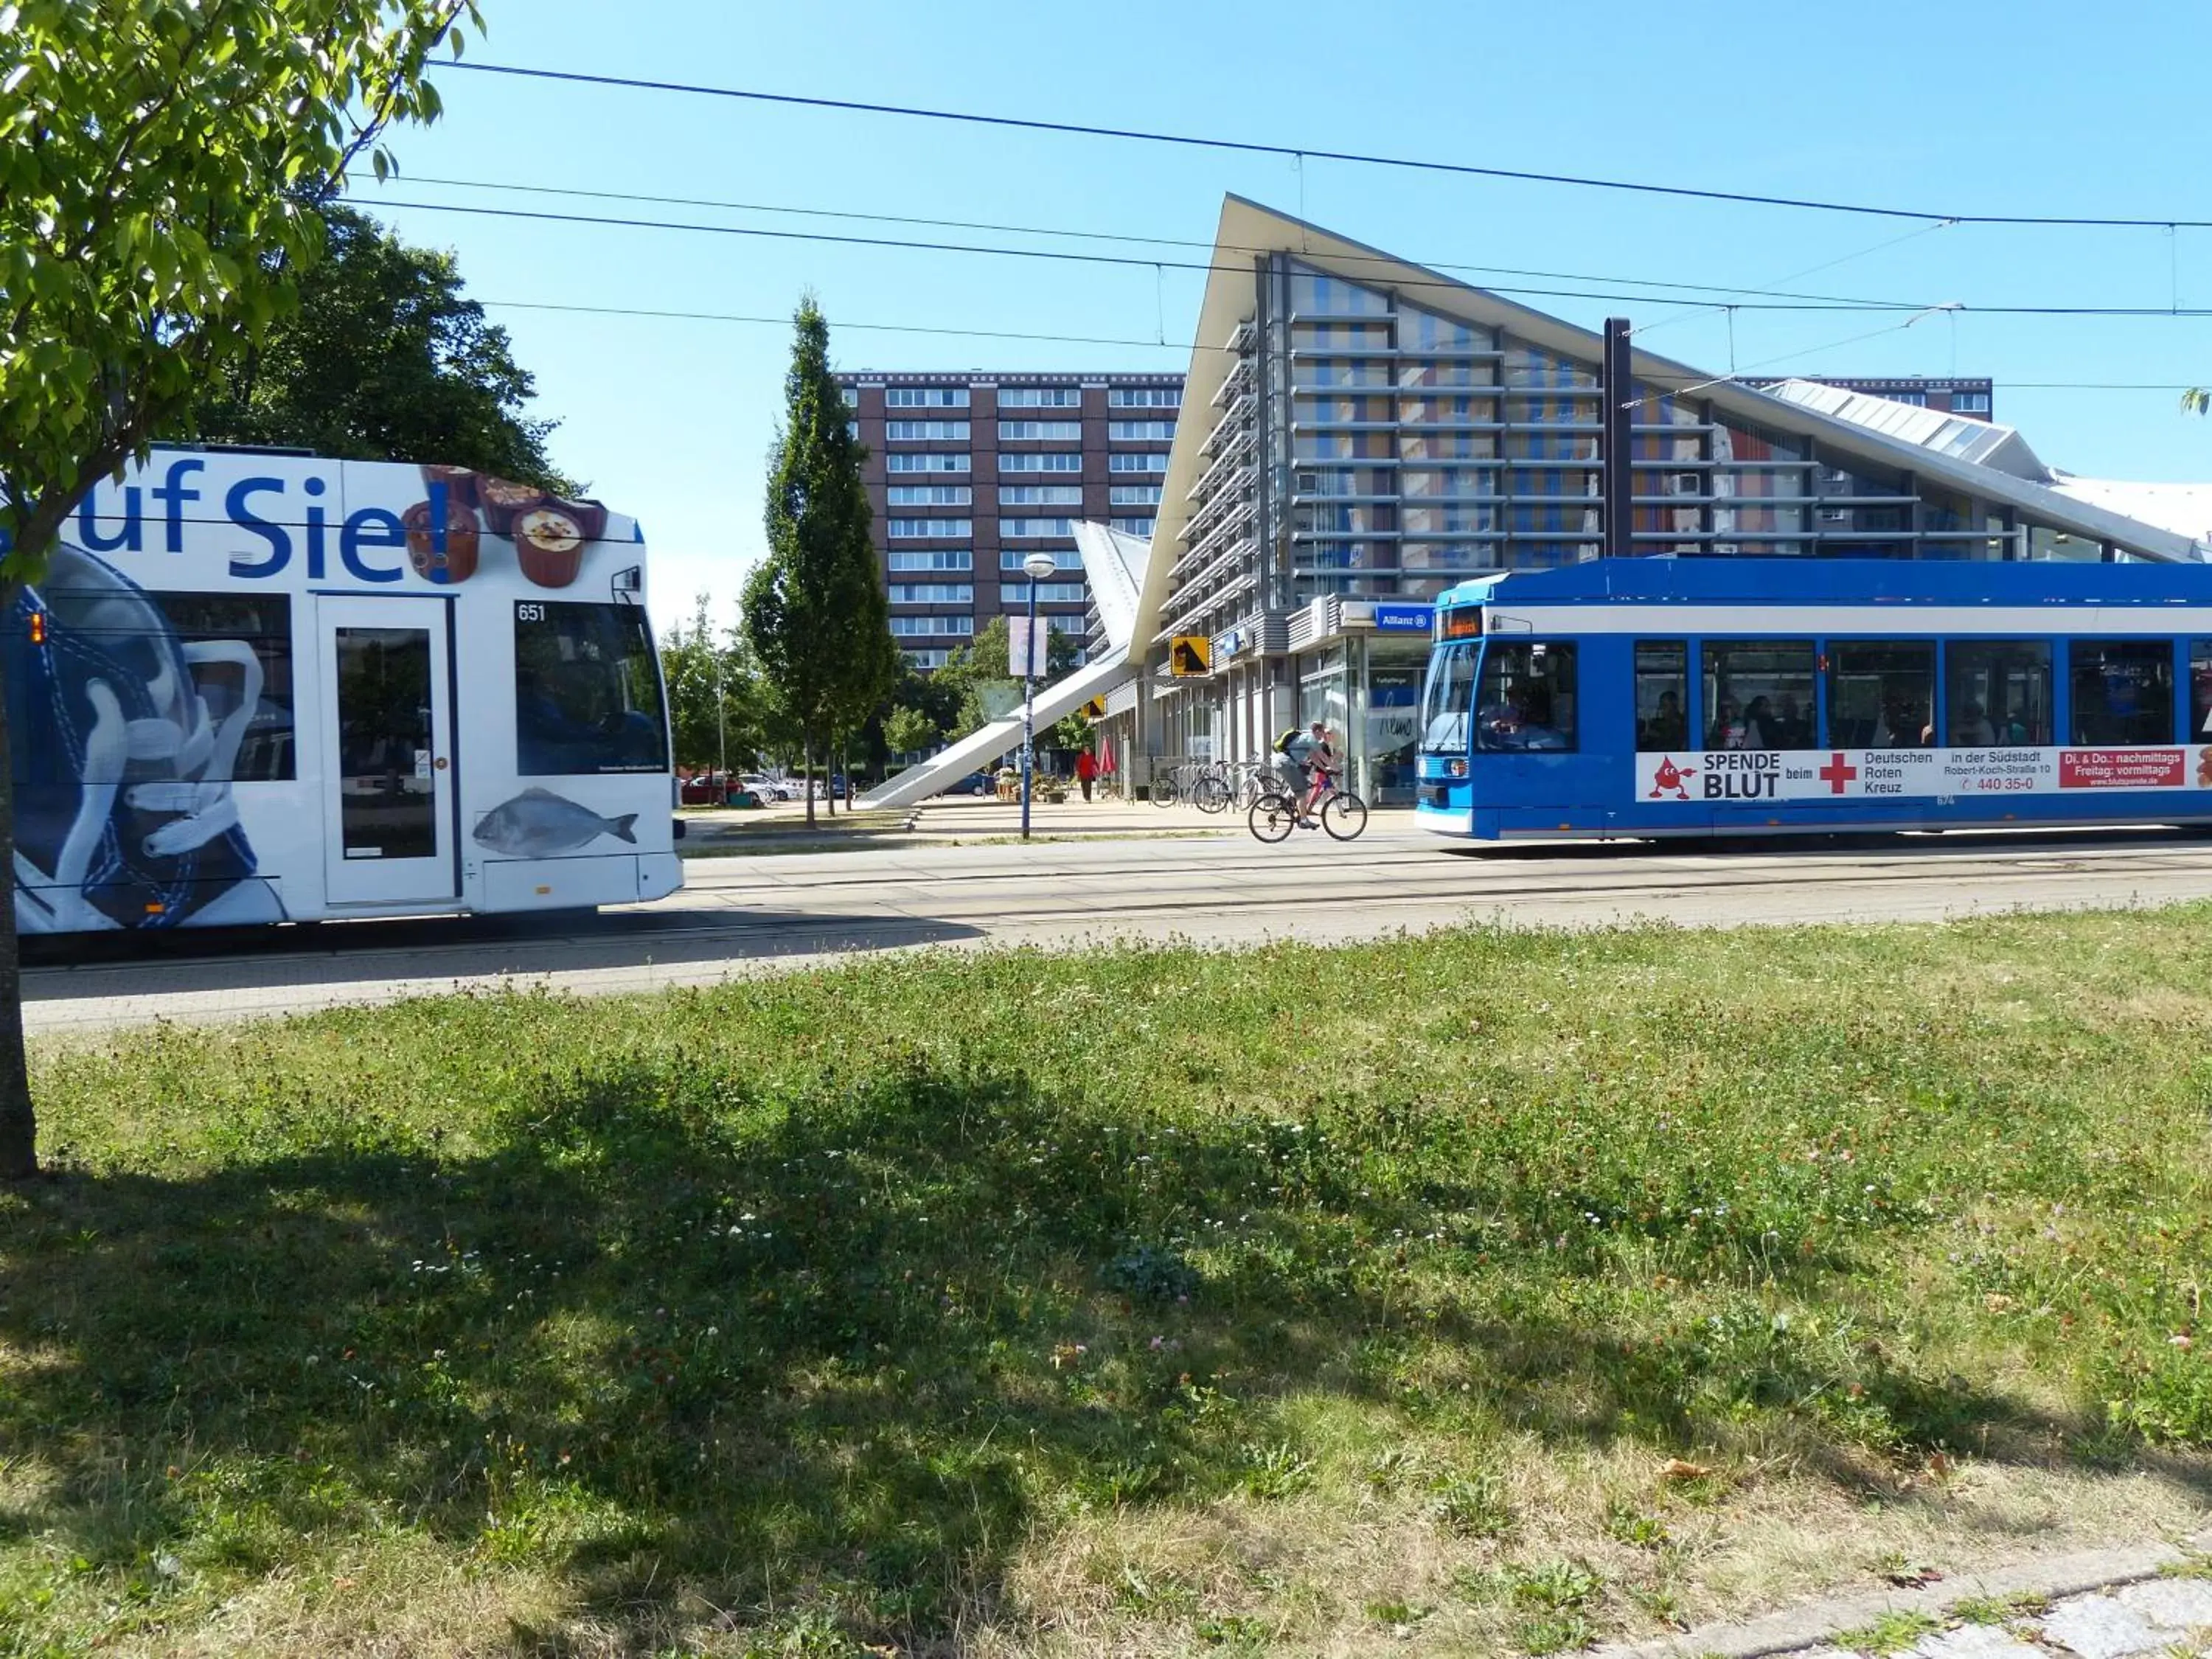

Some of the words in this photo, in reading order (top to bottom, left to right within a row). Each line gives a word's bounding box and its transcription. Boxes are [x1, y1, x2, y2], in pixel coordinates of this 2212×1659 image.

[225, 476, 449, 585] Sie!
[518, 604, 545, 622] 651
[1382, 616, 1413, 625] Allianz
[1704, 754, 1780, 771] SPENDE
[1865, 752, 1933, 764] Deutschen
[1952, 753, 1962, 763] in
[1966, 752, 1986, 763] der
[1989, 751, 2041, 763] Südstadt
[2065, 754, 2081, 765] Di.
[2116, 752, 2180, 765] nachmittags
[1786, 768, 1813, 780] beim
[1865, 766, 1902, 779] Roten
[2039, 765, 2051, 773] 10
[2075, 765, 2114, 778] Freitag:
[2117, 765, 2171, 776] vormittags
[1703, 773, 1780, 799] BLUT
[1865, 782, 1902, 793] Kreuz
[1978, 778, 2001, 790] 440
[2005, 777, 2034, 790] 35-0
